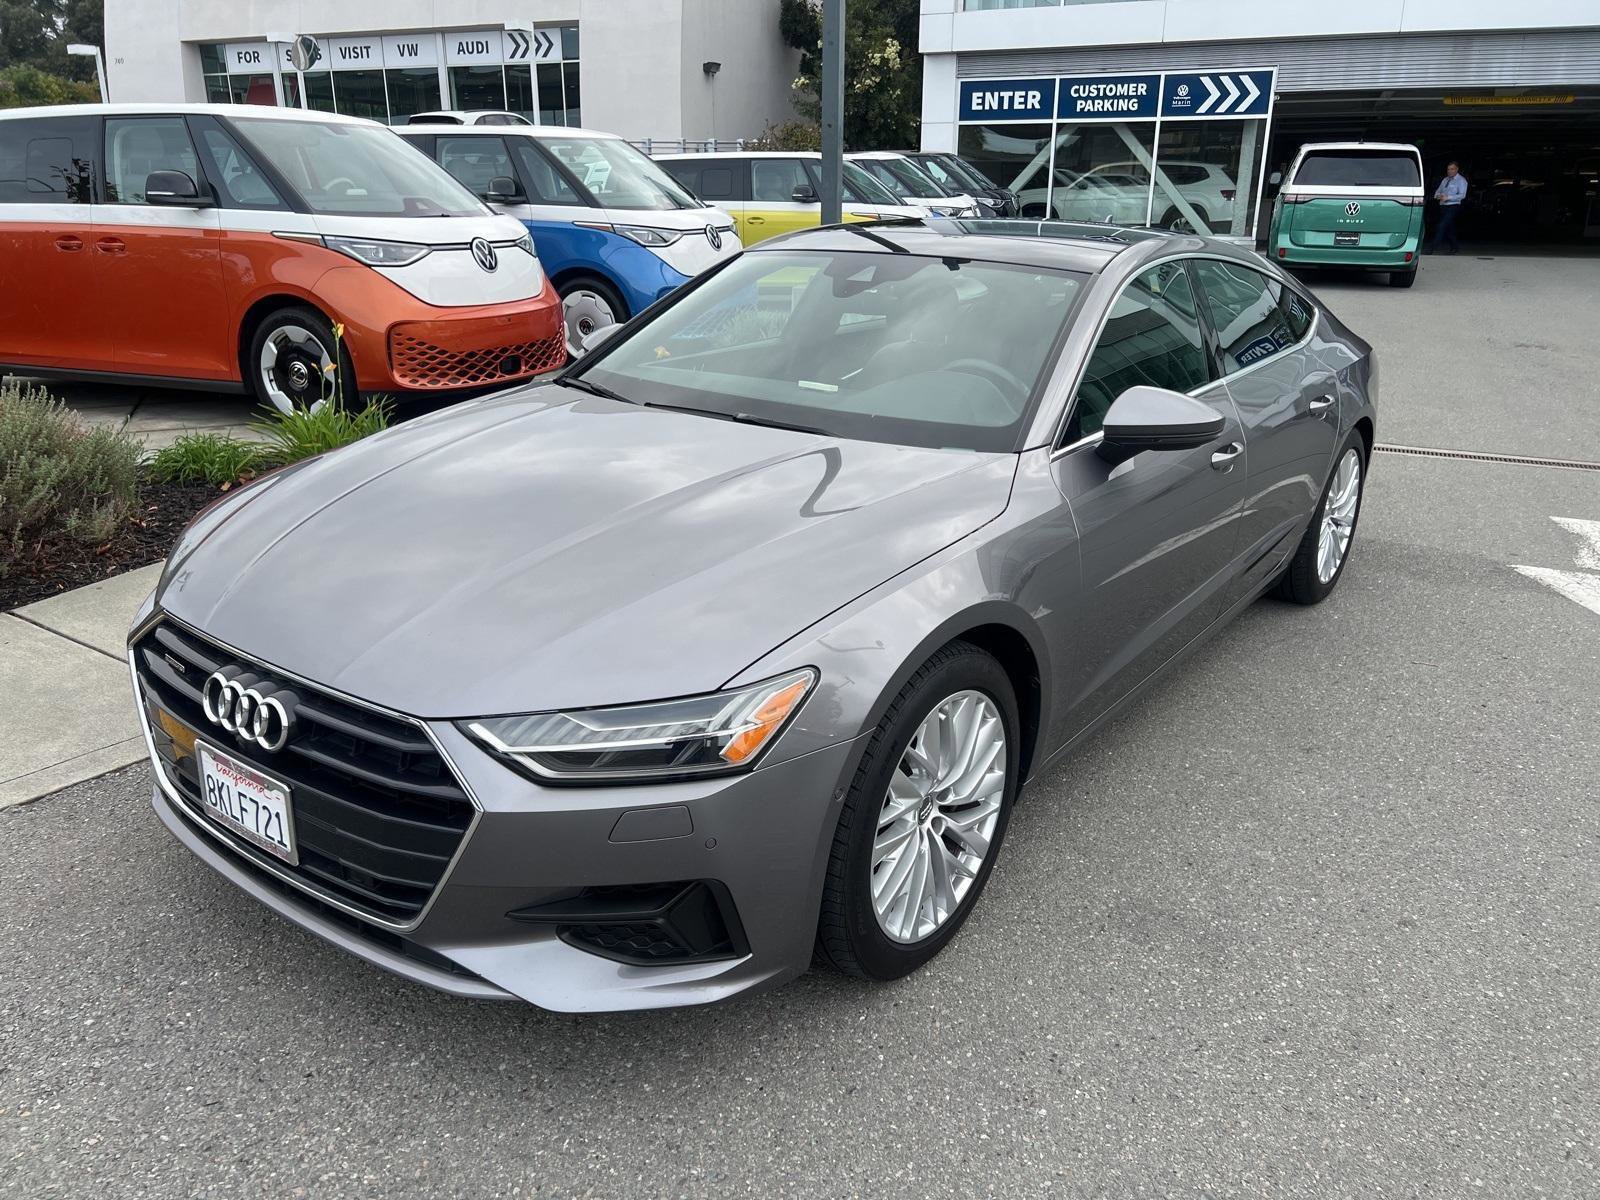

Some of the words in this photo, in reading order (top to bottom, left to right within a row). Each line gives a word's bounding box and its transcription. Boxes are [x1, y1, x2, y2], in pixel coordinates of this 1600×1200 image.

[237, 51, 261, 64] FOR
[339, 46, 372, 60] VISIT
[397, 43, 419, 58] VW
[457, 41, 490, 55] AUDI
[971, 90, 1042, 111] ENTER
[1070, 83, 1147, 97] CUSTOMER
[1076, 98, 1139, 112] PARKING
[206, 773, 288, 849] 8KLF721
